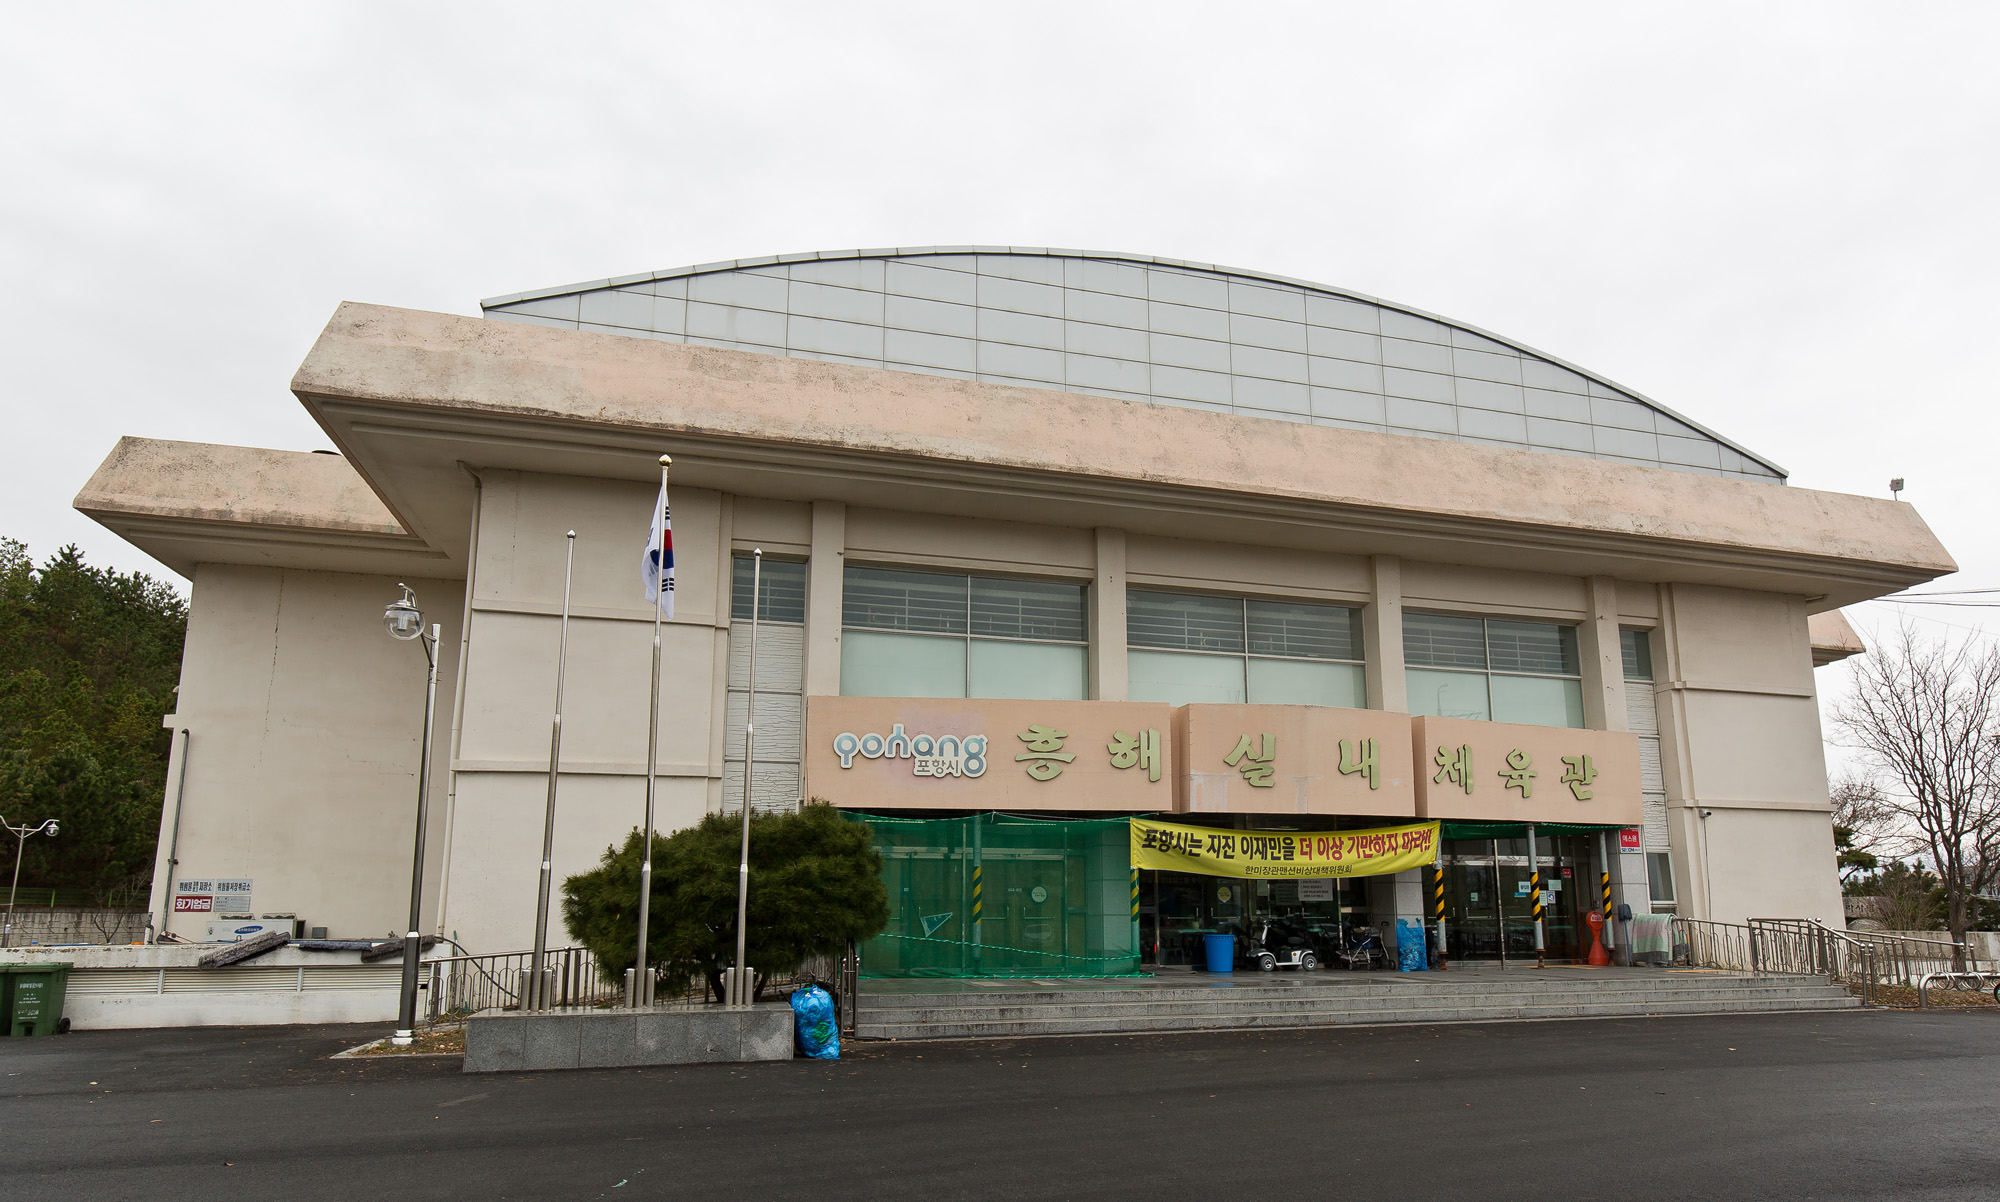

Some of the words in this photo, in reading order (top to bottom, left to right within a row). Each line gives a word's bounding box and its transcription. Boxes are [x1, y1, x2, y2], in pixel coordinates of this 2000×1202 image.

[916, 758, 959, 775] 포항시
[1434, 743, 1599, 801] 체육관
[1142, 828, 1203, 858] 포항시는
[1206, 834, 1236, 860] 지진
[1240, 836, 1296, 861] 이재민을
[1299, 837, 1313, 861] 더
[1317, 837, 1345, 861] 이상
[1347, 833, 1399, 859] 기만하지
[176, 898, 211, 910] 화기엄금
